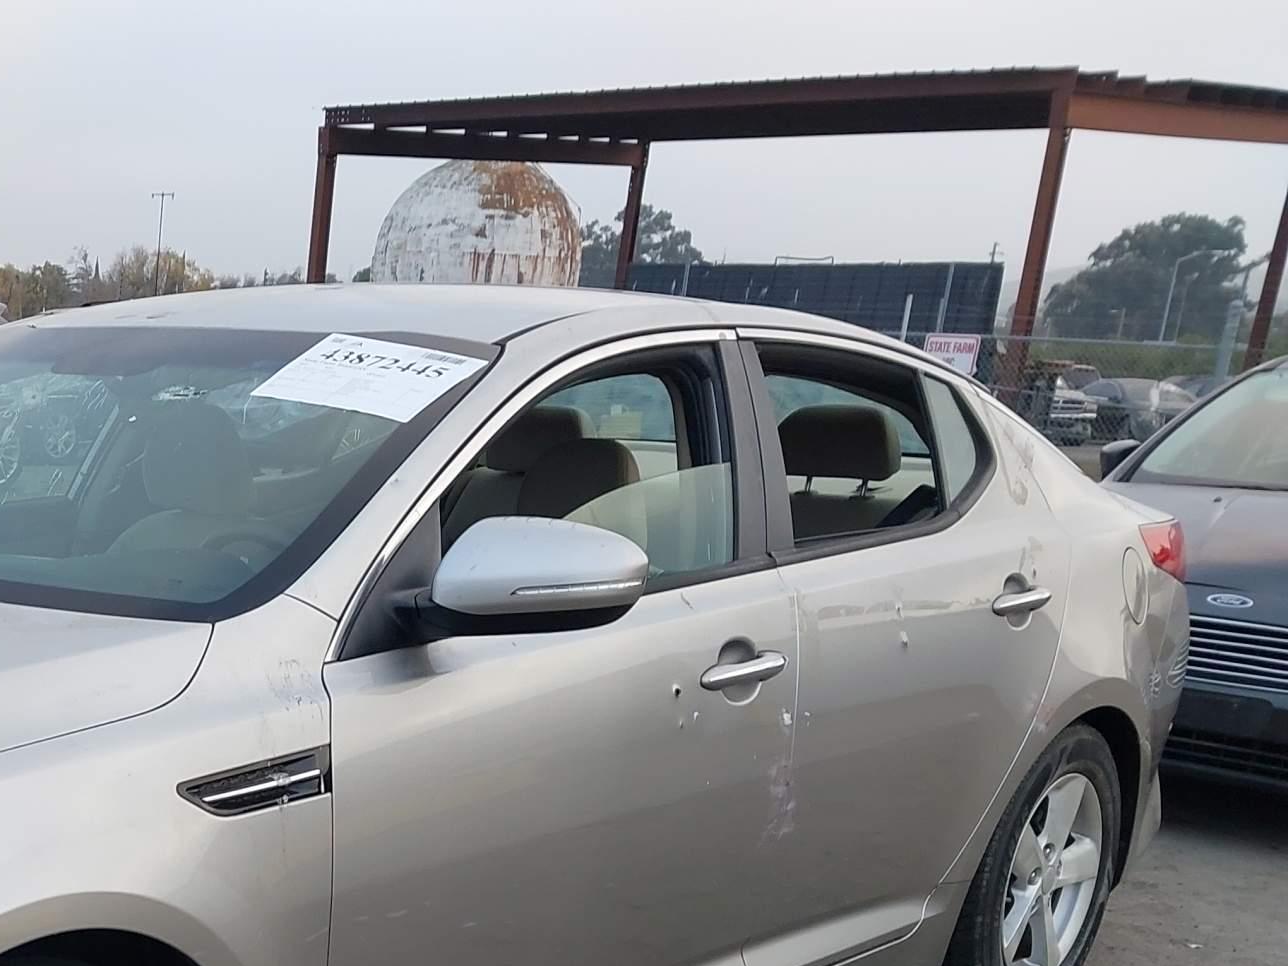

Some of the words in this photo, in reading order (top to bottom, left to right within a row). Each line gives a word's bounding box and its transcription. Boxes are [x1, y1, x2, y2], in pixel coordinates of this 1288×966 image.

[928, 341, 952, 352] STATE
[953, 342, 975, 353] FARM
[320, 348, 451, 378] 43872445
